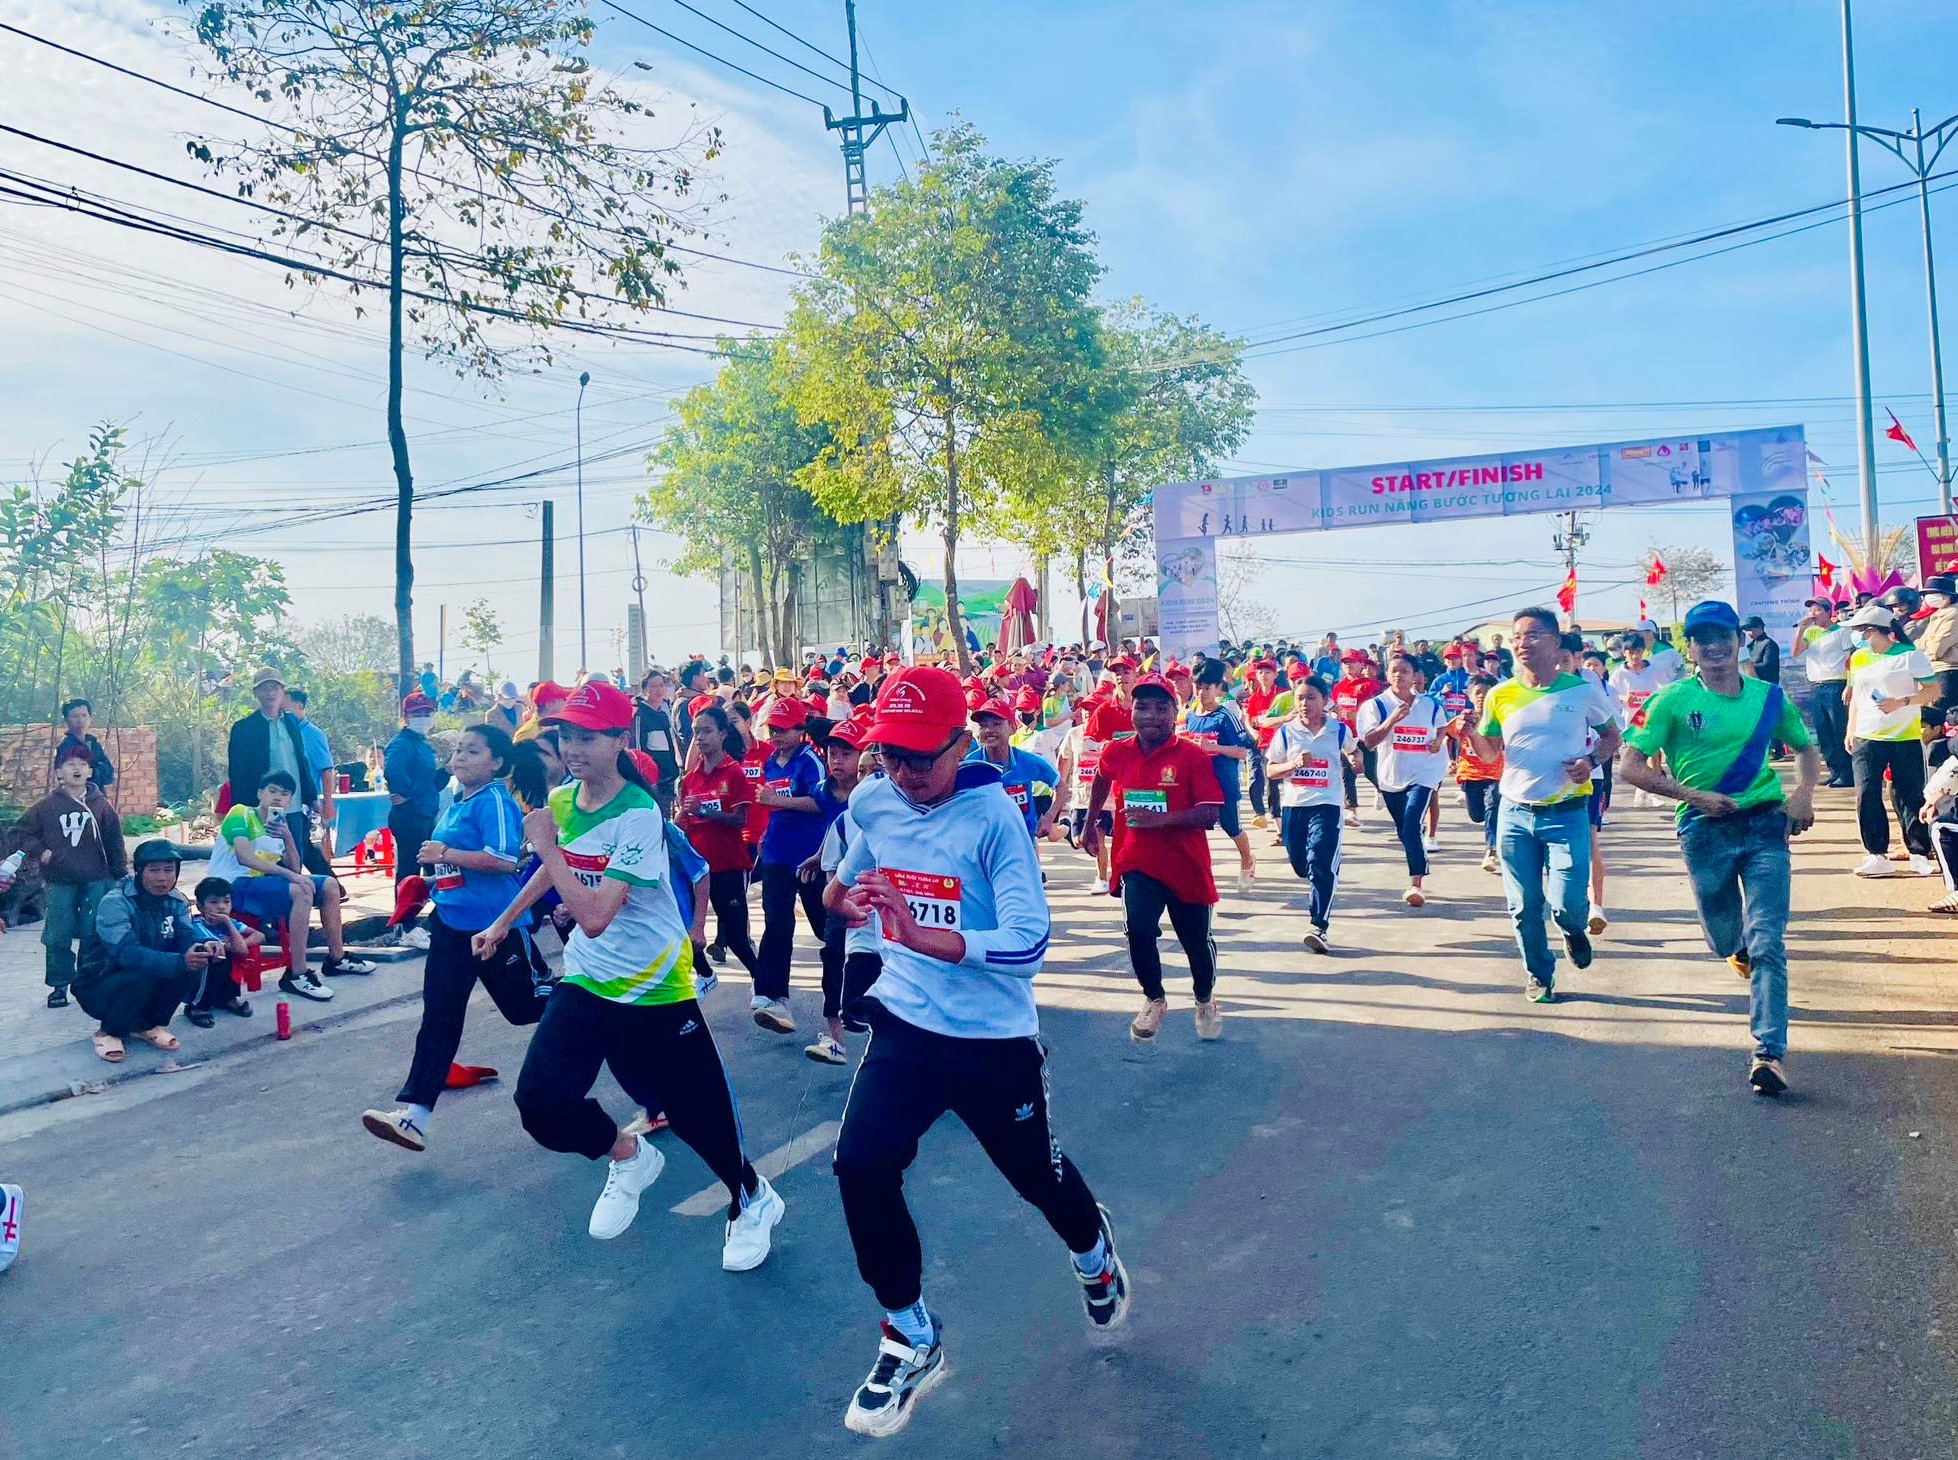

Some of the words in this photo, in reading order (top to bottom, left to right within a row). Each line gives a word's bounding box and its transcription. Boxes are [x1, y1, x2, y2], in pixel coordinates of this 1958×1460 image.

[1371, 463, 1543, 495] START/FINISH
[1311, 505, 1344, 519] KIDS
[1348, 502, 1380, 516] RUN
[1433, 493, 1478, 509] BƯỚC
[1545, 486, 1571, 500] LAI
[1575, 483, 1612, 497] 2024
[1396, 735, 1426, 743] 246737
[744, 768, 759, 776] 707
[1294, 769, 1327, 778] 246740
